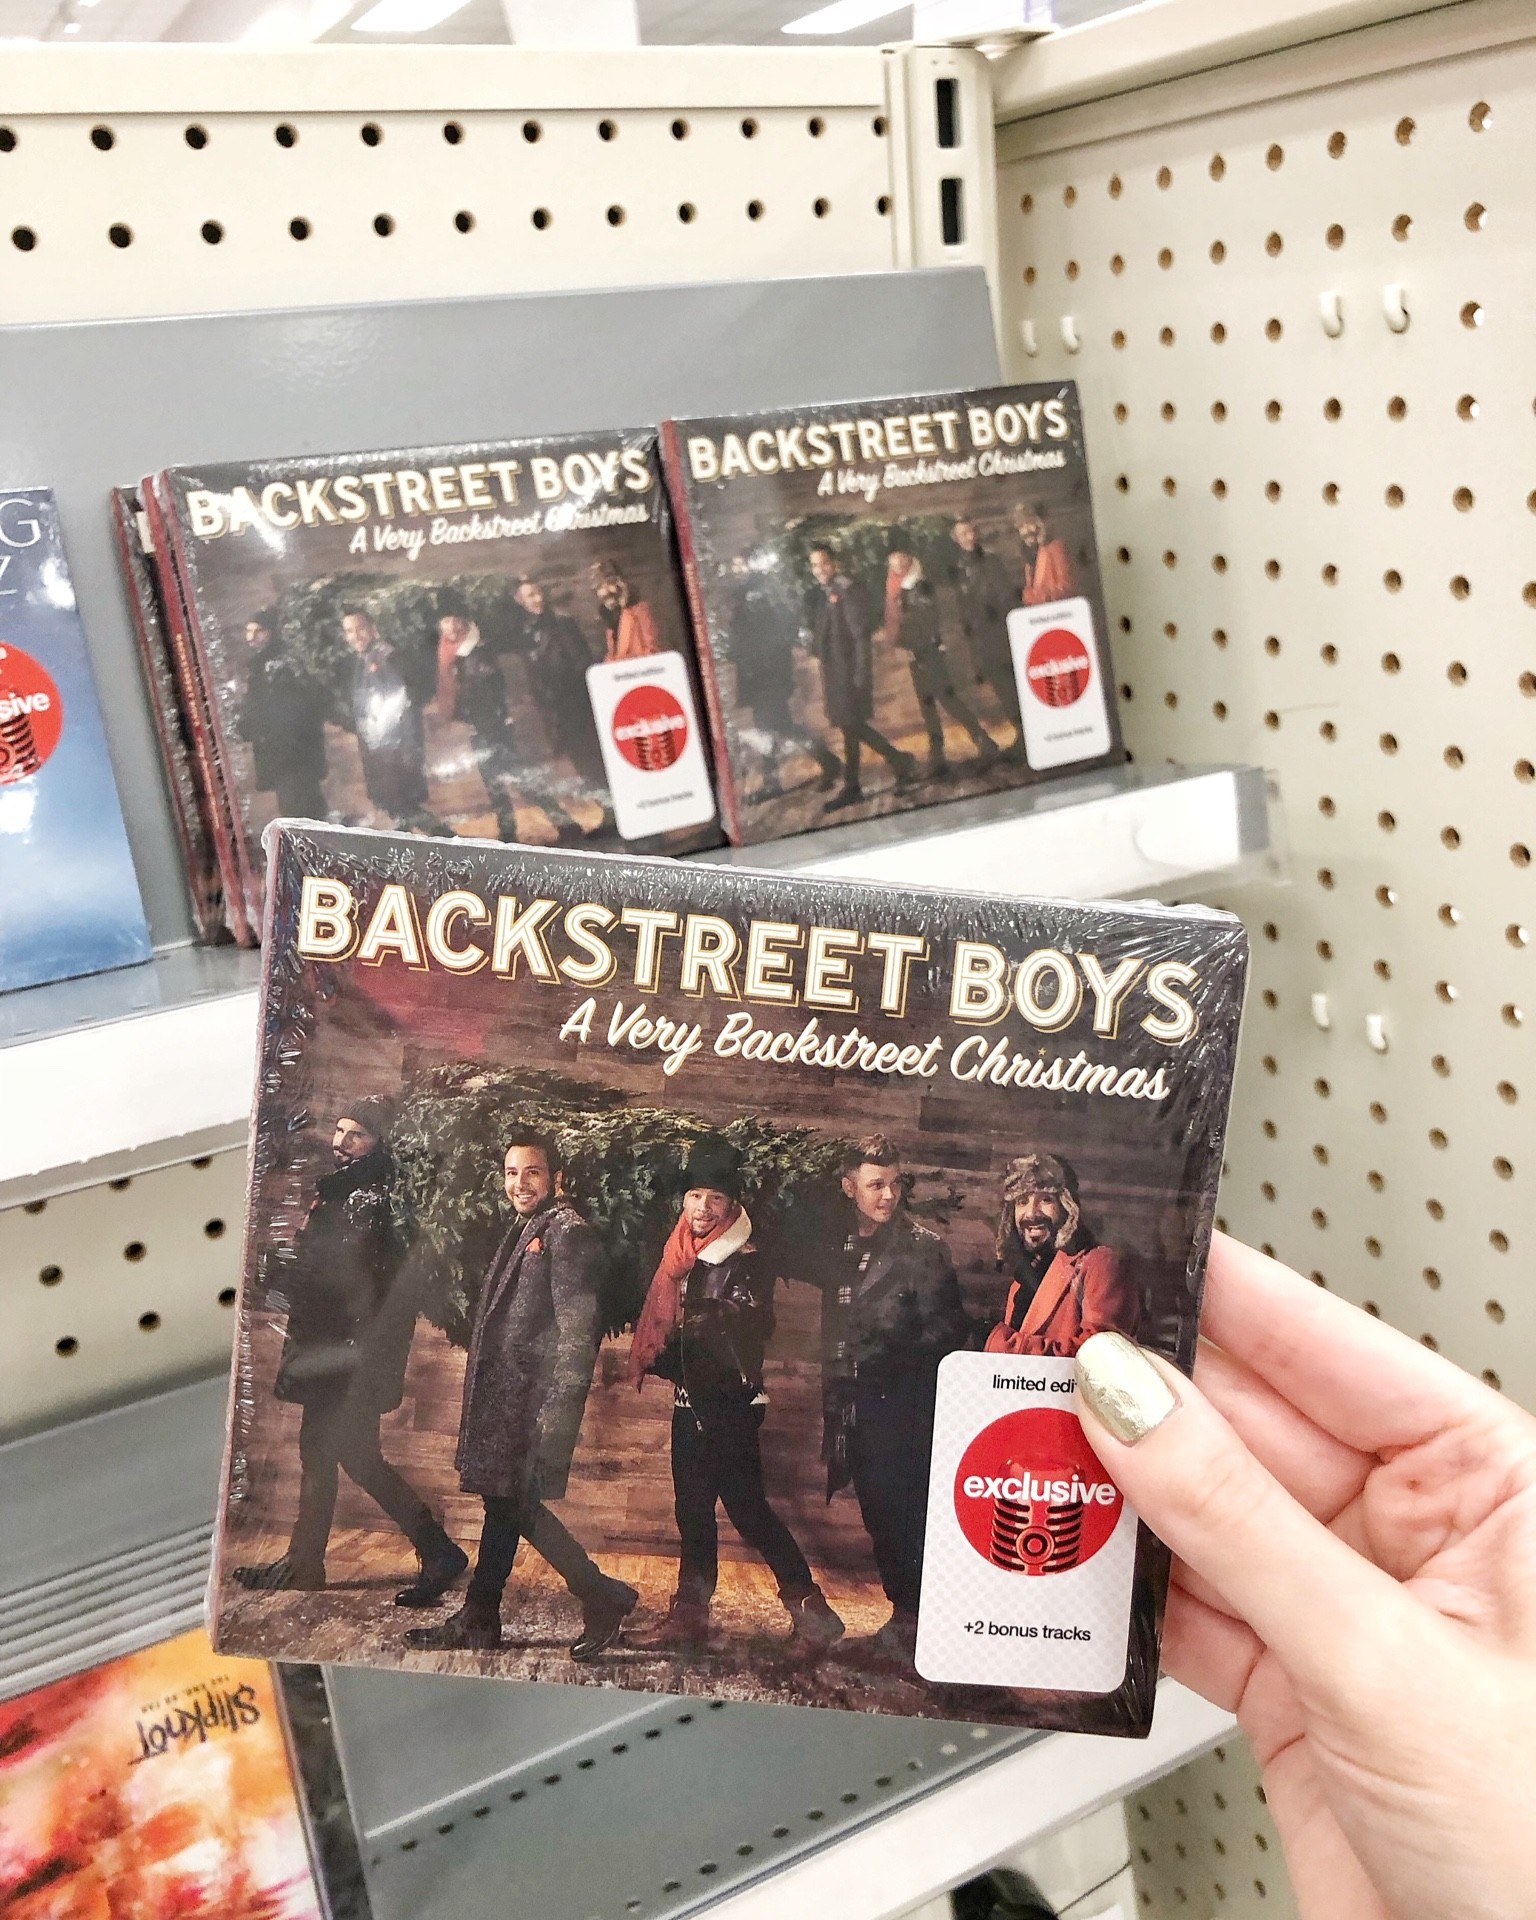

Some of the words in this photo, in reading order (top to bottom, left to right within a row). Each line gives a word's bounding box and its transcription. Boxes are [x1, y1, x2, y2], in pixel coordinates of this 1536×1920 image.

[687, 409, 960, 482] BACKSTREET
[967, 398, 1070, 451] BOYS
[186, 459, 521, 540] BACKSTREET
[530, 449, 654, 503] BOYS
[817, 470, 835, 496] A
[349, 526, 367, 554] A
[373, 524, 426, 561] Very
[430, 510, 542, 546] Backstreet
[298, 875, 930, 1019] BACKSTREET
[948, 940, 1203, 1047] BOYS
[559, 997, 598, 1044] A
[606, 1002, 703, 1077] Very
[713, 1011, 943, 1079] Backstreet
[950, 1035, 1170, 1101] Christmas
[992, 1374, 1046, 1391] limited
[1050, 1378, 1077, 1393] edi
[963, 1471, 1116, 1505] exclusive
[963, 1620, 984, 1635] +2
[988, 1621, 1038, 1638] bonus
[1042, 1625, 1091, 1641] tracks
